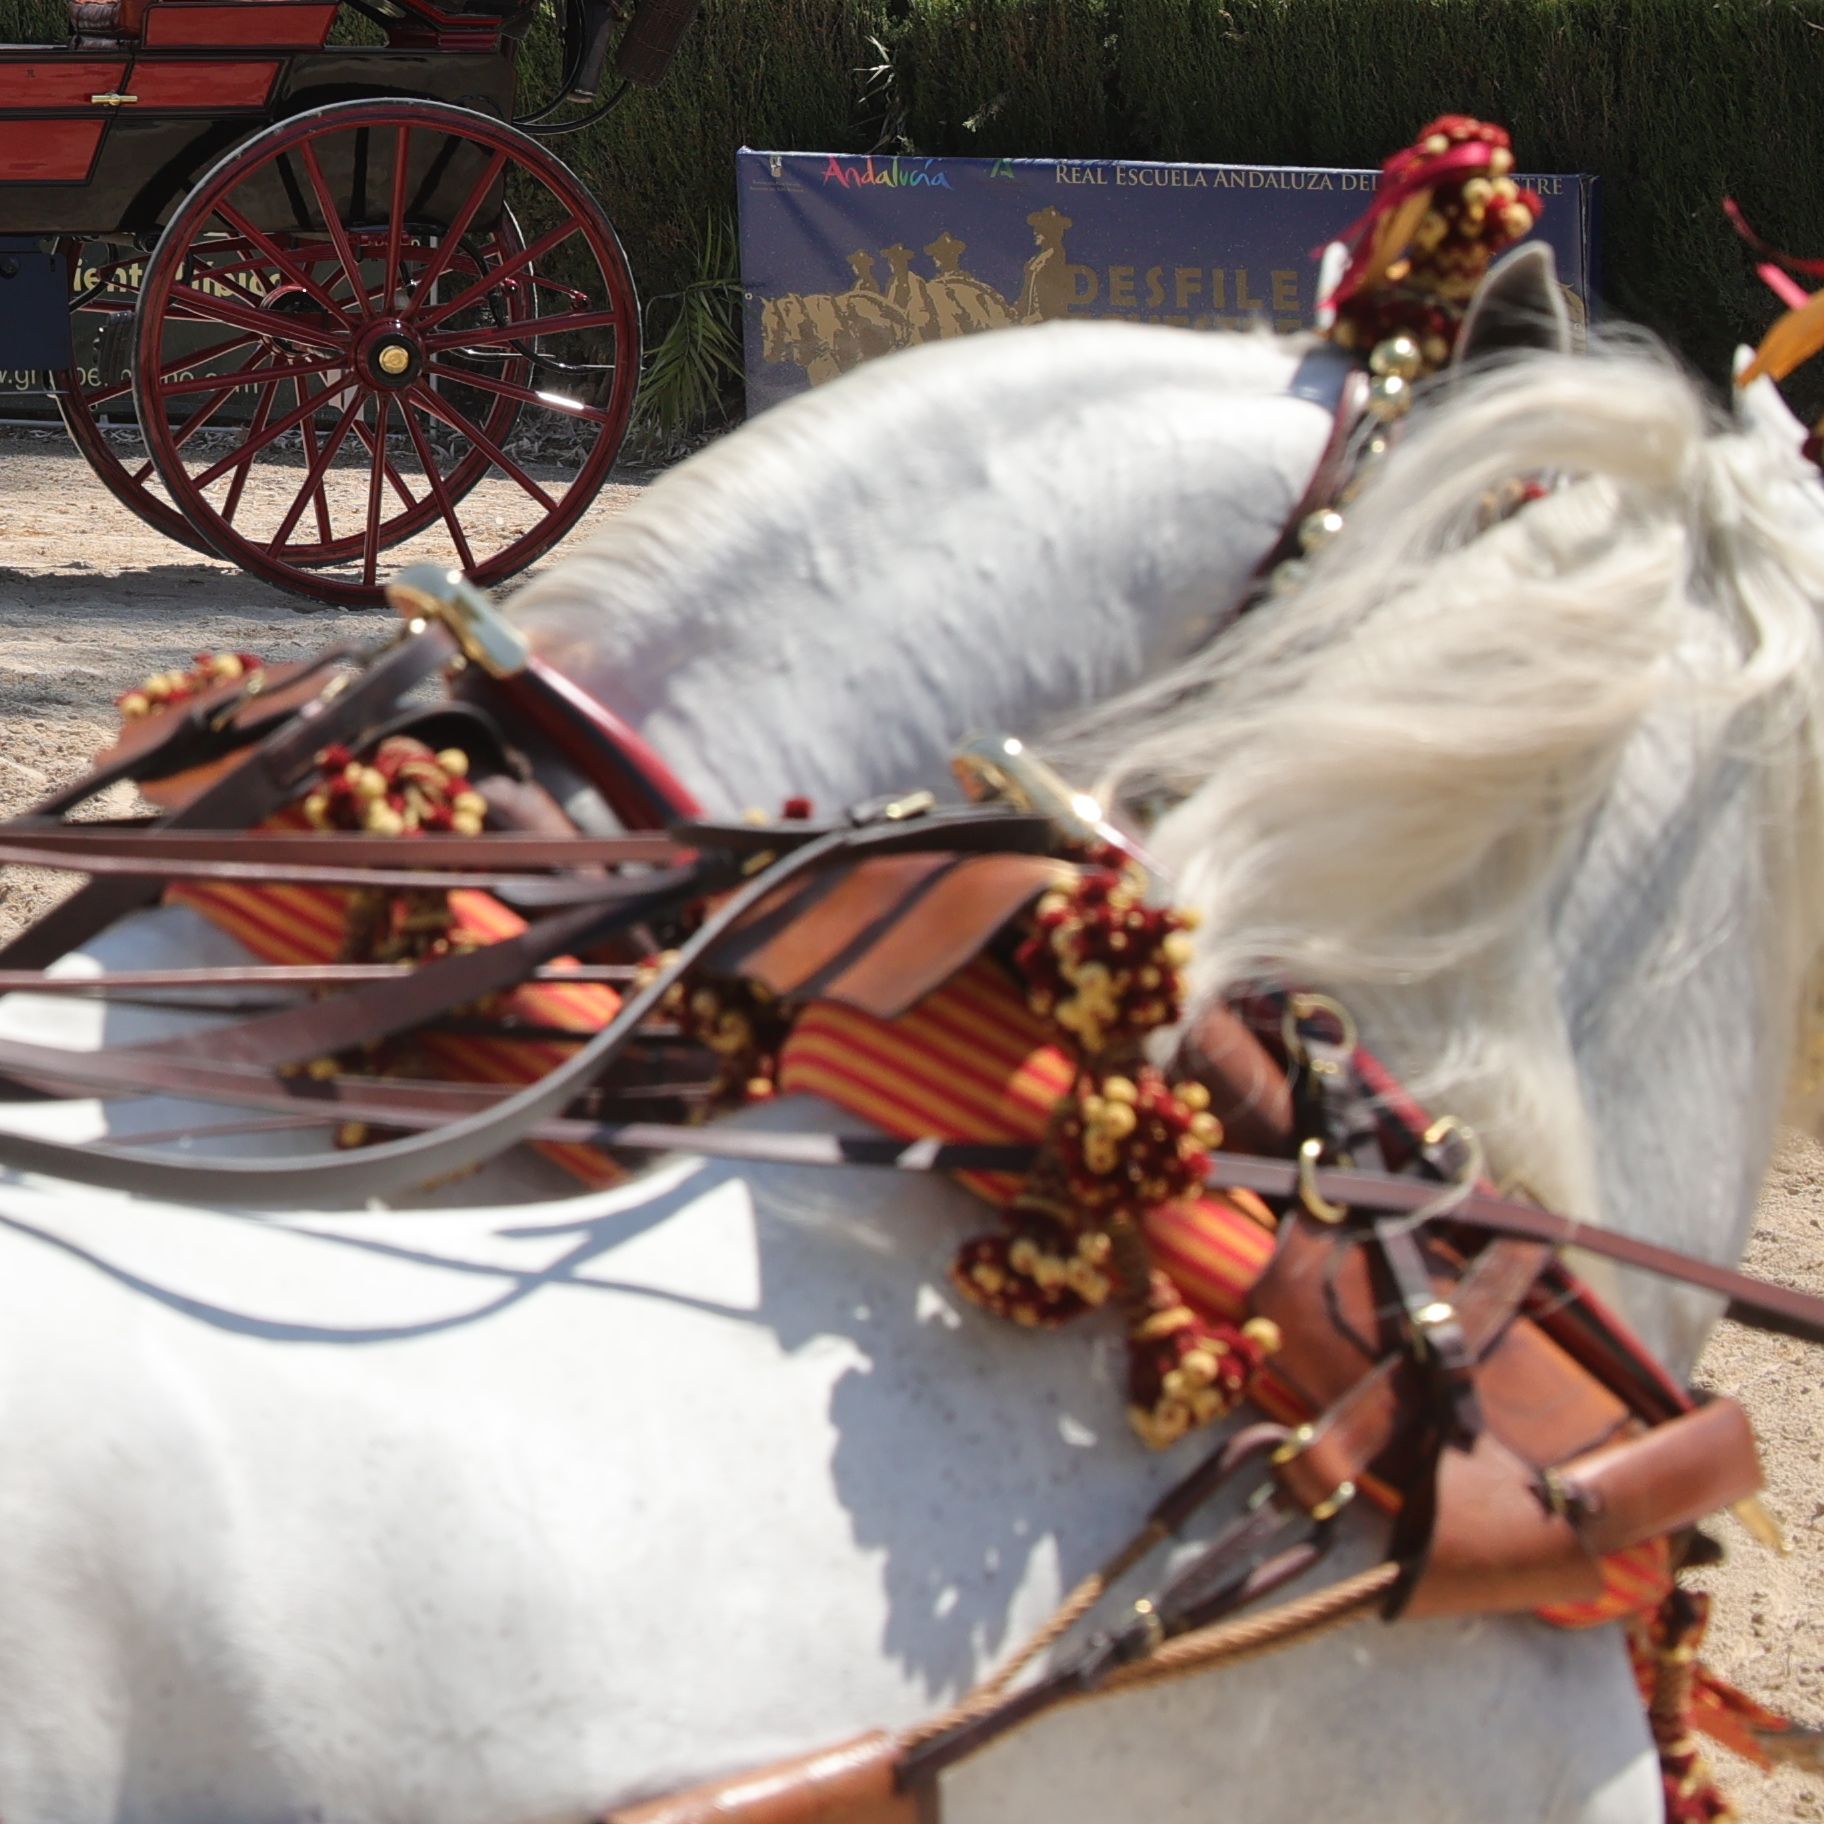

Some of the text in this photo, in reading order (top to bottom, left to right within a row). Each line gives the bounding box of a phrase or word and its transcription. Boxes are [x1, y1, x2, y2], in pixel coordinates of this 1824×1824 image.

[822, 156, 953, 190] Andalucía
[1055, 163, 1108, 185] REAL
[1115, 165, 1204, 188] ESCUELA
[1213, 168, 1334, 191] ANDALUZA
[1067, 264, 1300, 311] DESFILE
